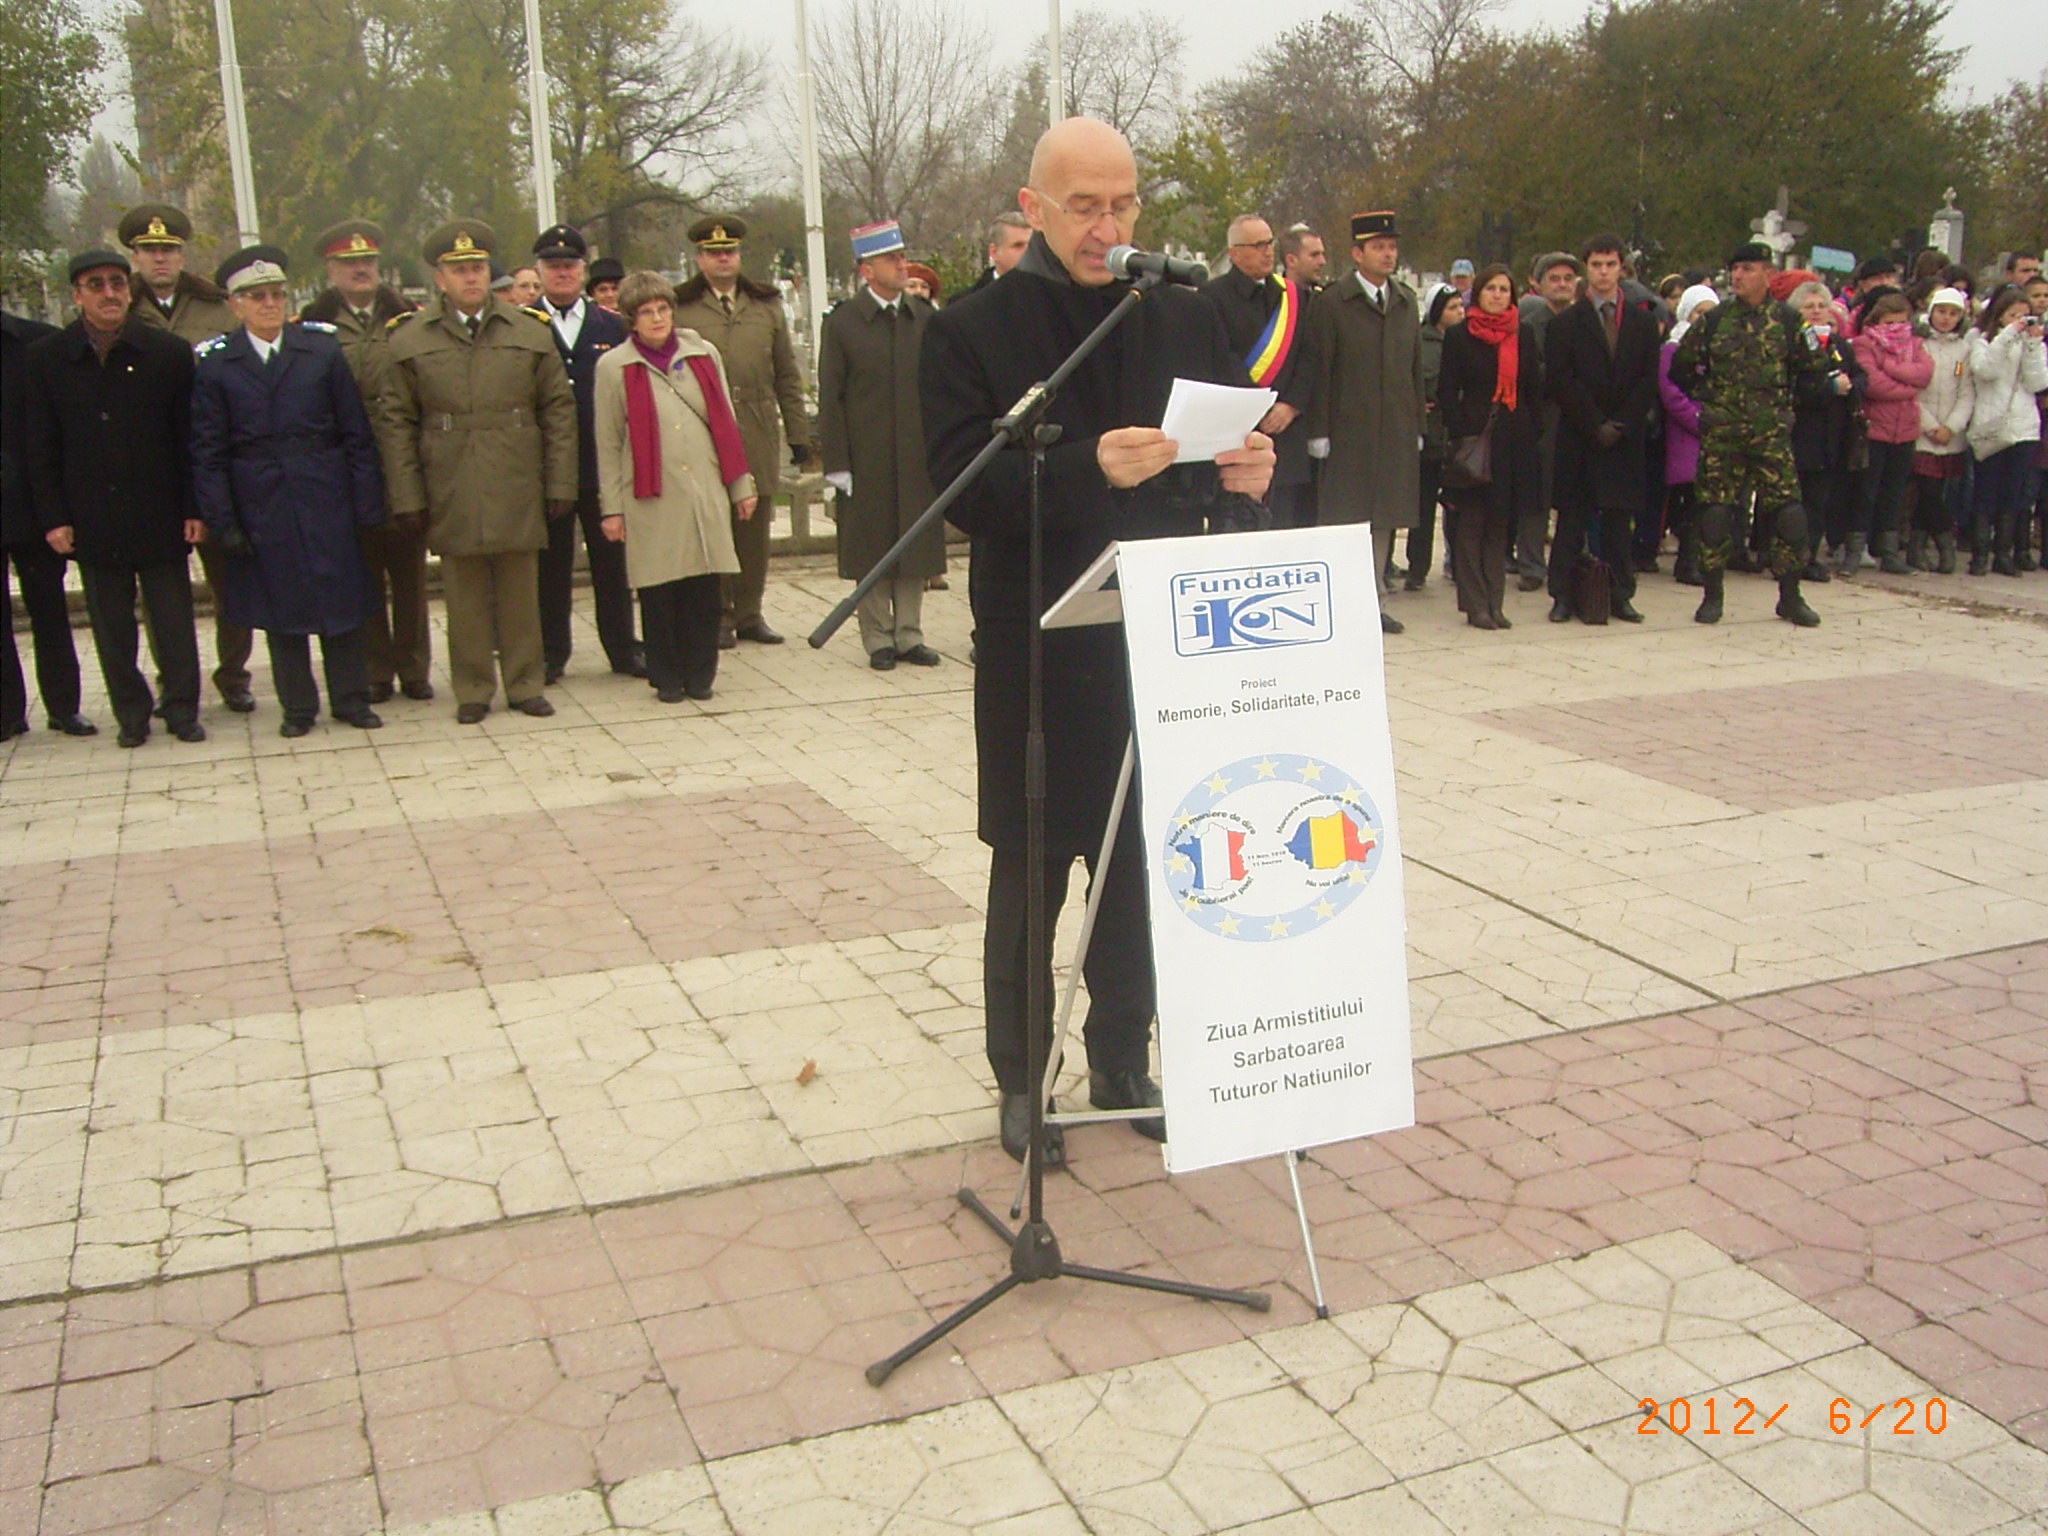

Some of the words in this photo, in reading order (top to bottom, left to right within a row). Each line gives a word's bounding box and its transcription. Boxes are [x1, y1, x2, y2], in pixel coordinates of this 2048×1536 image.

[1240, 677, 1278, 690] Proiect
[1157, 703, 1227, 724] Memorie,
[1231, 693, 1320, 715] Solidaritate,
[1324, 688, 1362, 703] Pace
[1229, 812, 1241, 822] de
[1241, 819, 1256, 836] dire
[1206, 1022, 1248, 1043] Ziua
[1253, 997, 1364, 1034] Armistitiului
[1233, 1035, 1345, 1069] Sarbatoarea
[1208, 1079, 1278, 1104] Tuturor
[1283, 1061, 1372, 1091] Natiunilor
